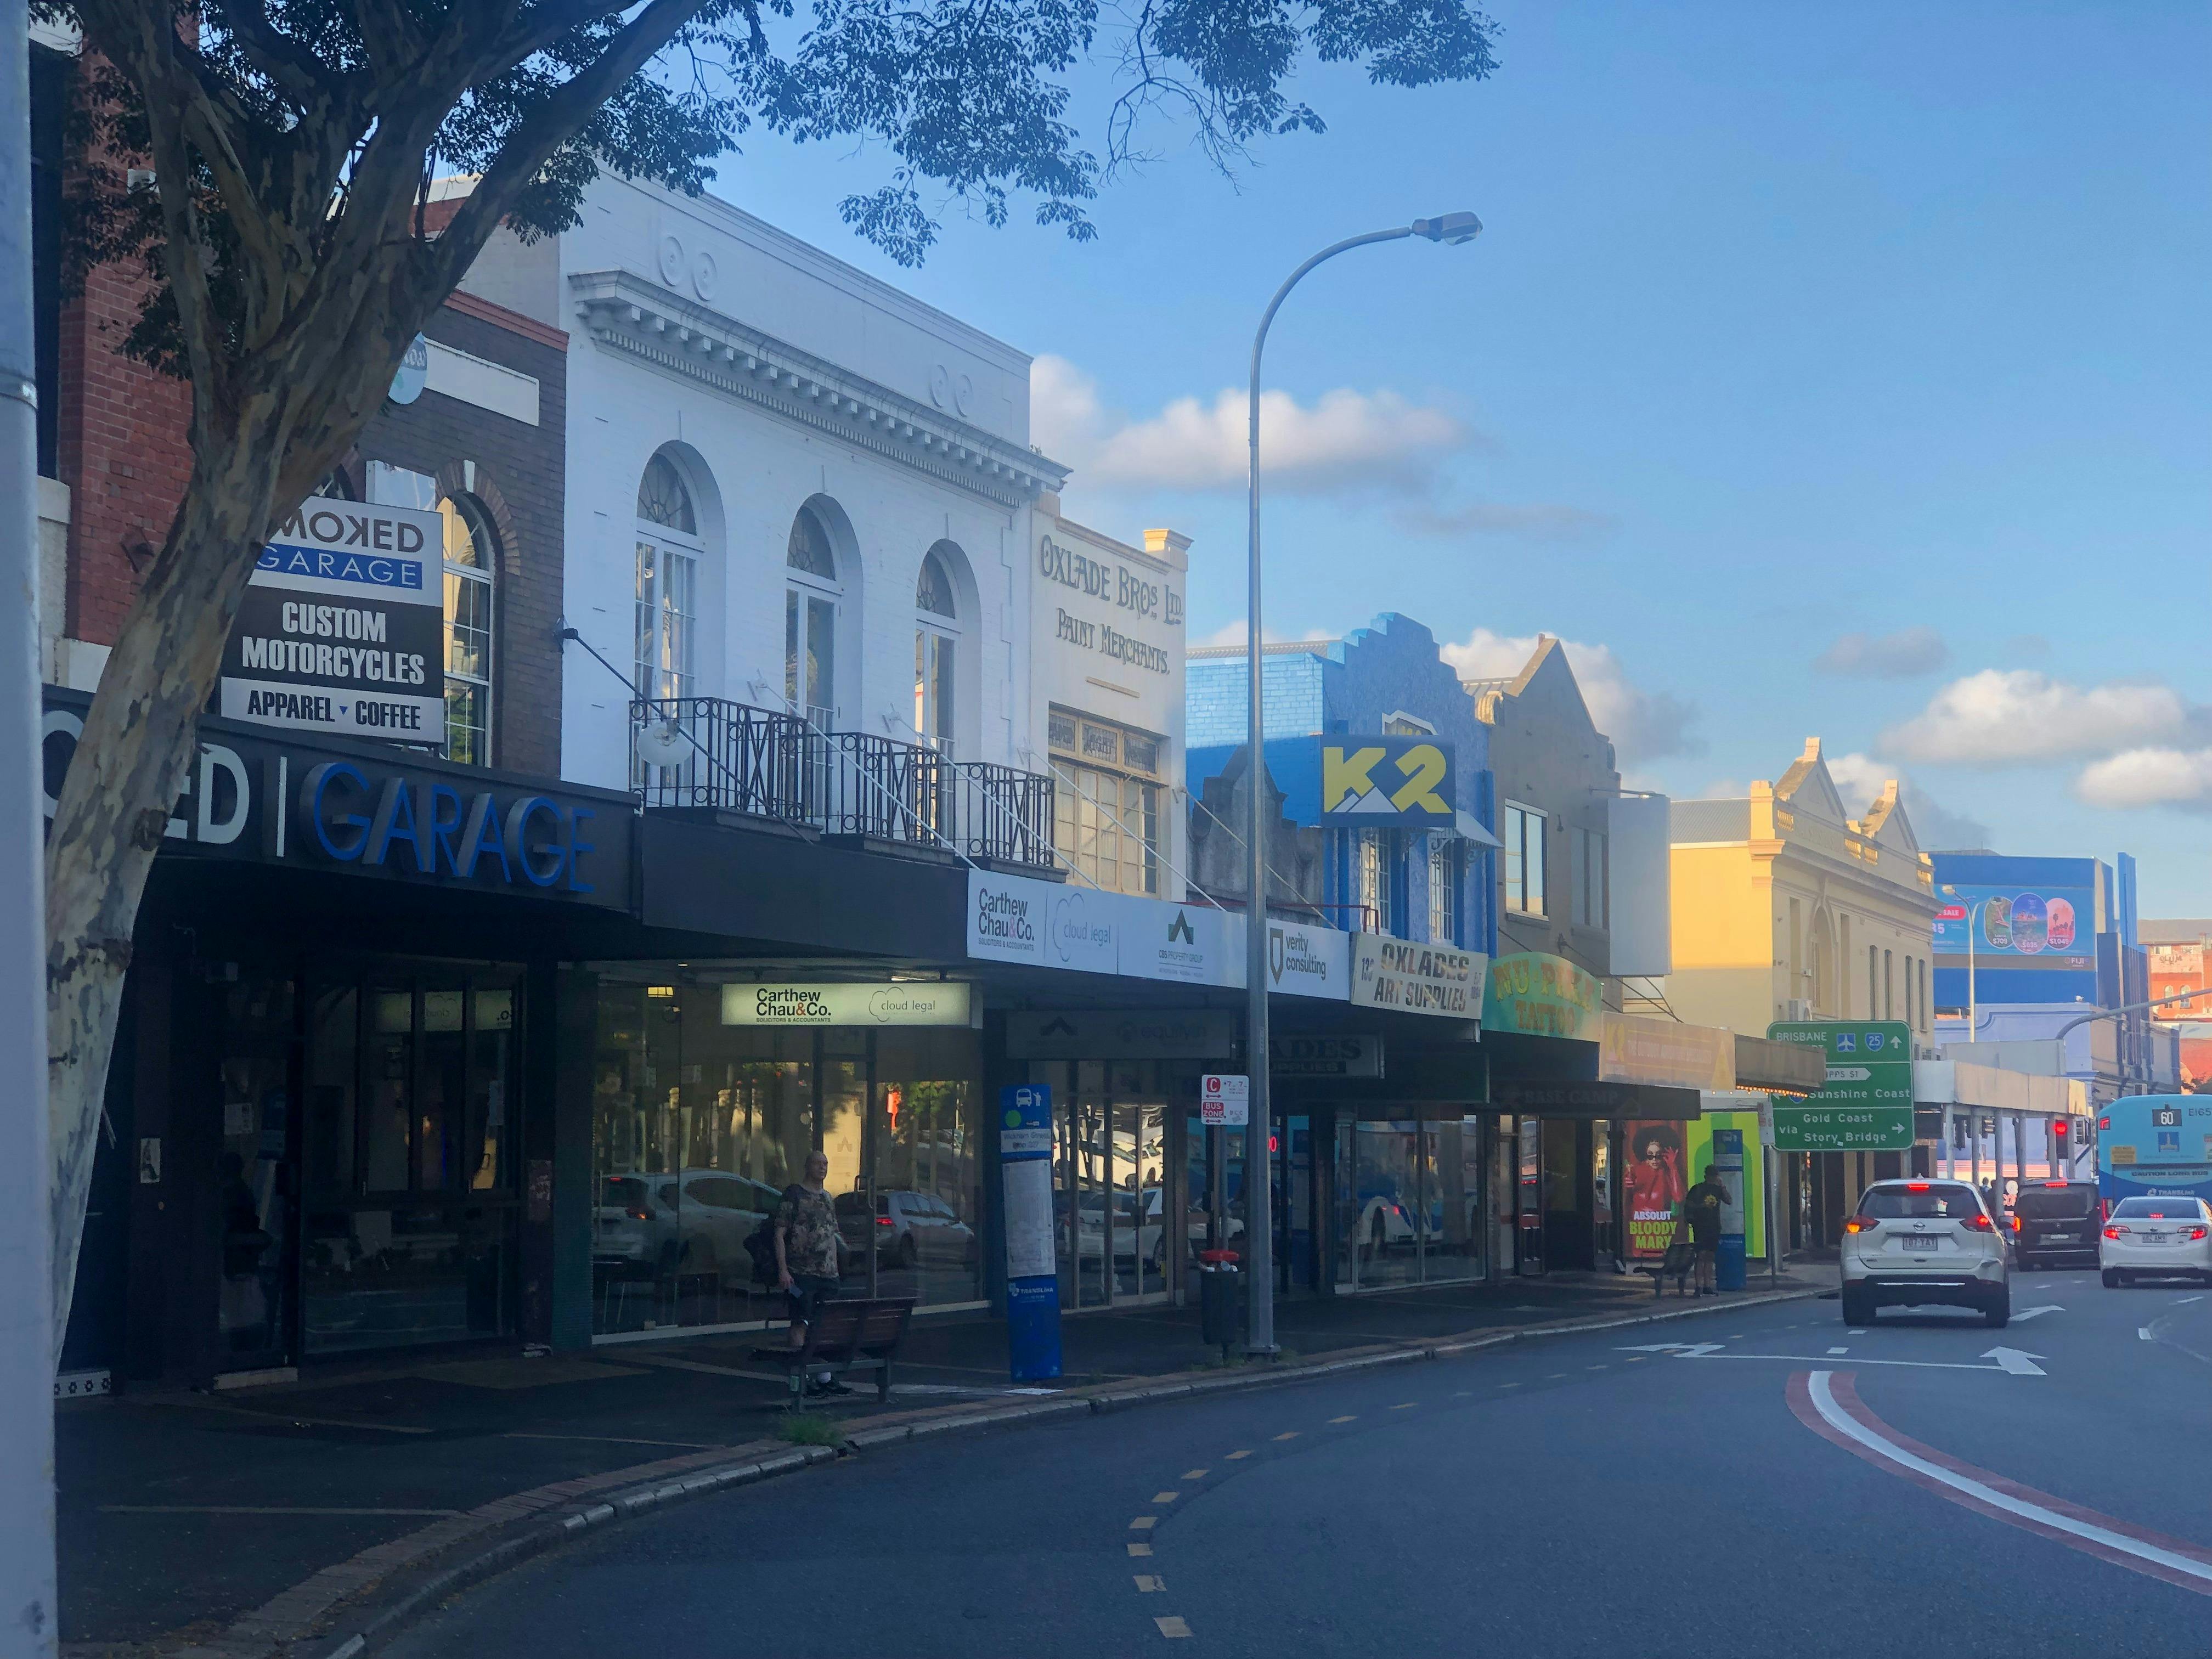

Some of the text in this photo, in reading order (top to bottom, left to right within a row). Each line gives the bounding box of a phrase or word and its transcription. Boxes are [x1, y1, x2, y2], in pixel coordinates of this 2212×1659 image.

[257, 545, 416, 586] GARAGE
[1040, 534, 1110, 602] OXLADE
[283, 601, 386, 642] CUSTOM
[1056, 607, 1096, 649] PAINT
[241, 635, 425, 685] MOTORCYCLES
[247, 689, 421, 730] APPAREL COFFEE
[1324, 744, 1453, 813] K2
[304, 760, 596, 893] GARAGE
[979, 888, 1028, 917] Carthew
[978, 911, 1035, 941] Chau&Co.
[1063, 918, 1111, 947] cloud legal
[1285, 931, 1308, 958] verity
[1285, 953, 1326, 981] consulting
[1380, 943, 1470, 982] OXLADES
[756, 988, 821, 1002] Carthew
[881, 1000, 935, 1012] cloud legal
[1373, 977, 1403, 1004] ART
[1406, 981, 1467, 1012] SUPPLIES
[756, 1002, 832, 1016] Chau&Co.
[1776, 1032, 1881, 1047] BRISBANE 25
[1809, 1088, 1910, 1099] Sunshine Coast
[1779, 1125, 1798, 1134] via
[1803, 1114, 1874, 1123] Gold Coast
[2160, 1111, 2174, 1125] 60
[1804, 1132, 1887, 1143] Story Bridge
[1629, 1221, 1678, 1235] BLOODY
[1633, 1211, 1672, 1221] ABSOLUT
[1635, 1235, 1672, 1249] MARY
